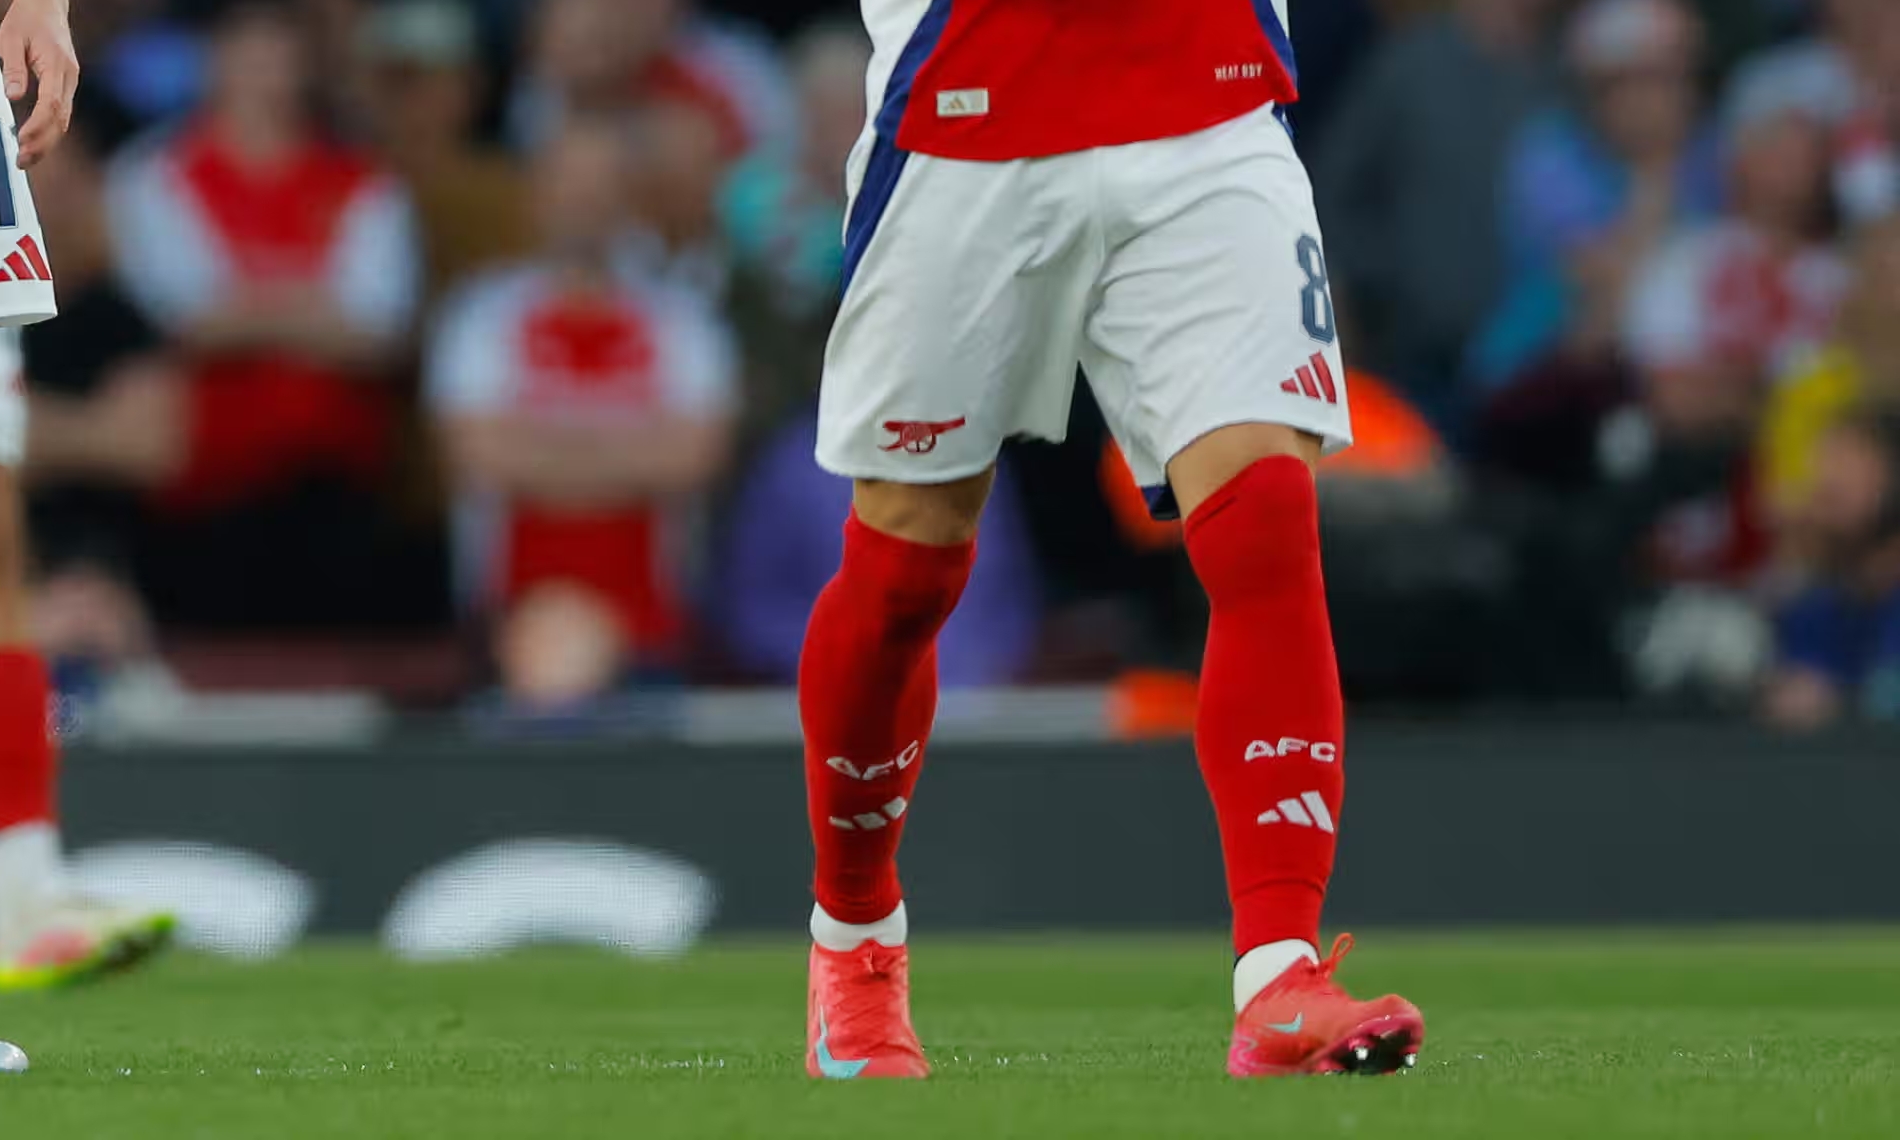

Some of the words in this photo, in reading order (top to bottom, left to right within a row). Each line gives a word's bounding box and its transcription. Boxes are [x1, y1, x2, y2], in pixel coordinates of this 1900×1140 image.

[1296, 233, 1335, 344] 8
[826, 739, 918, 781] AFC
[1244, 736, 1336, 763] AFC
